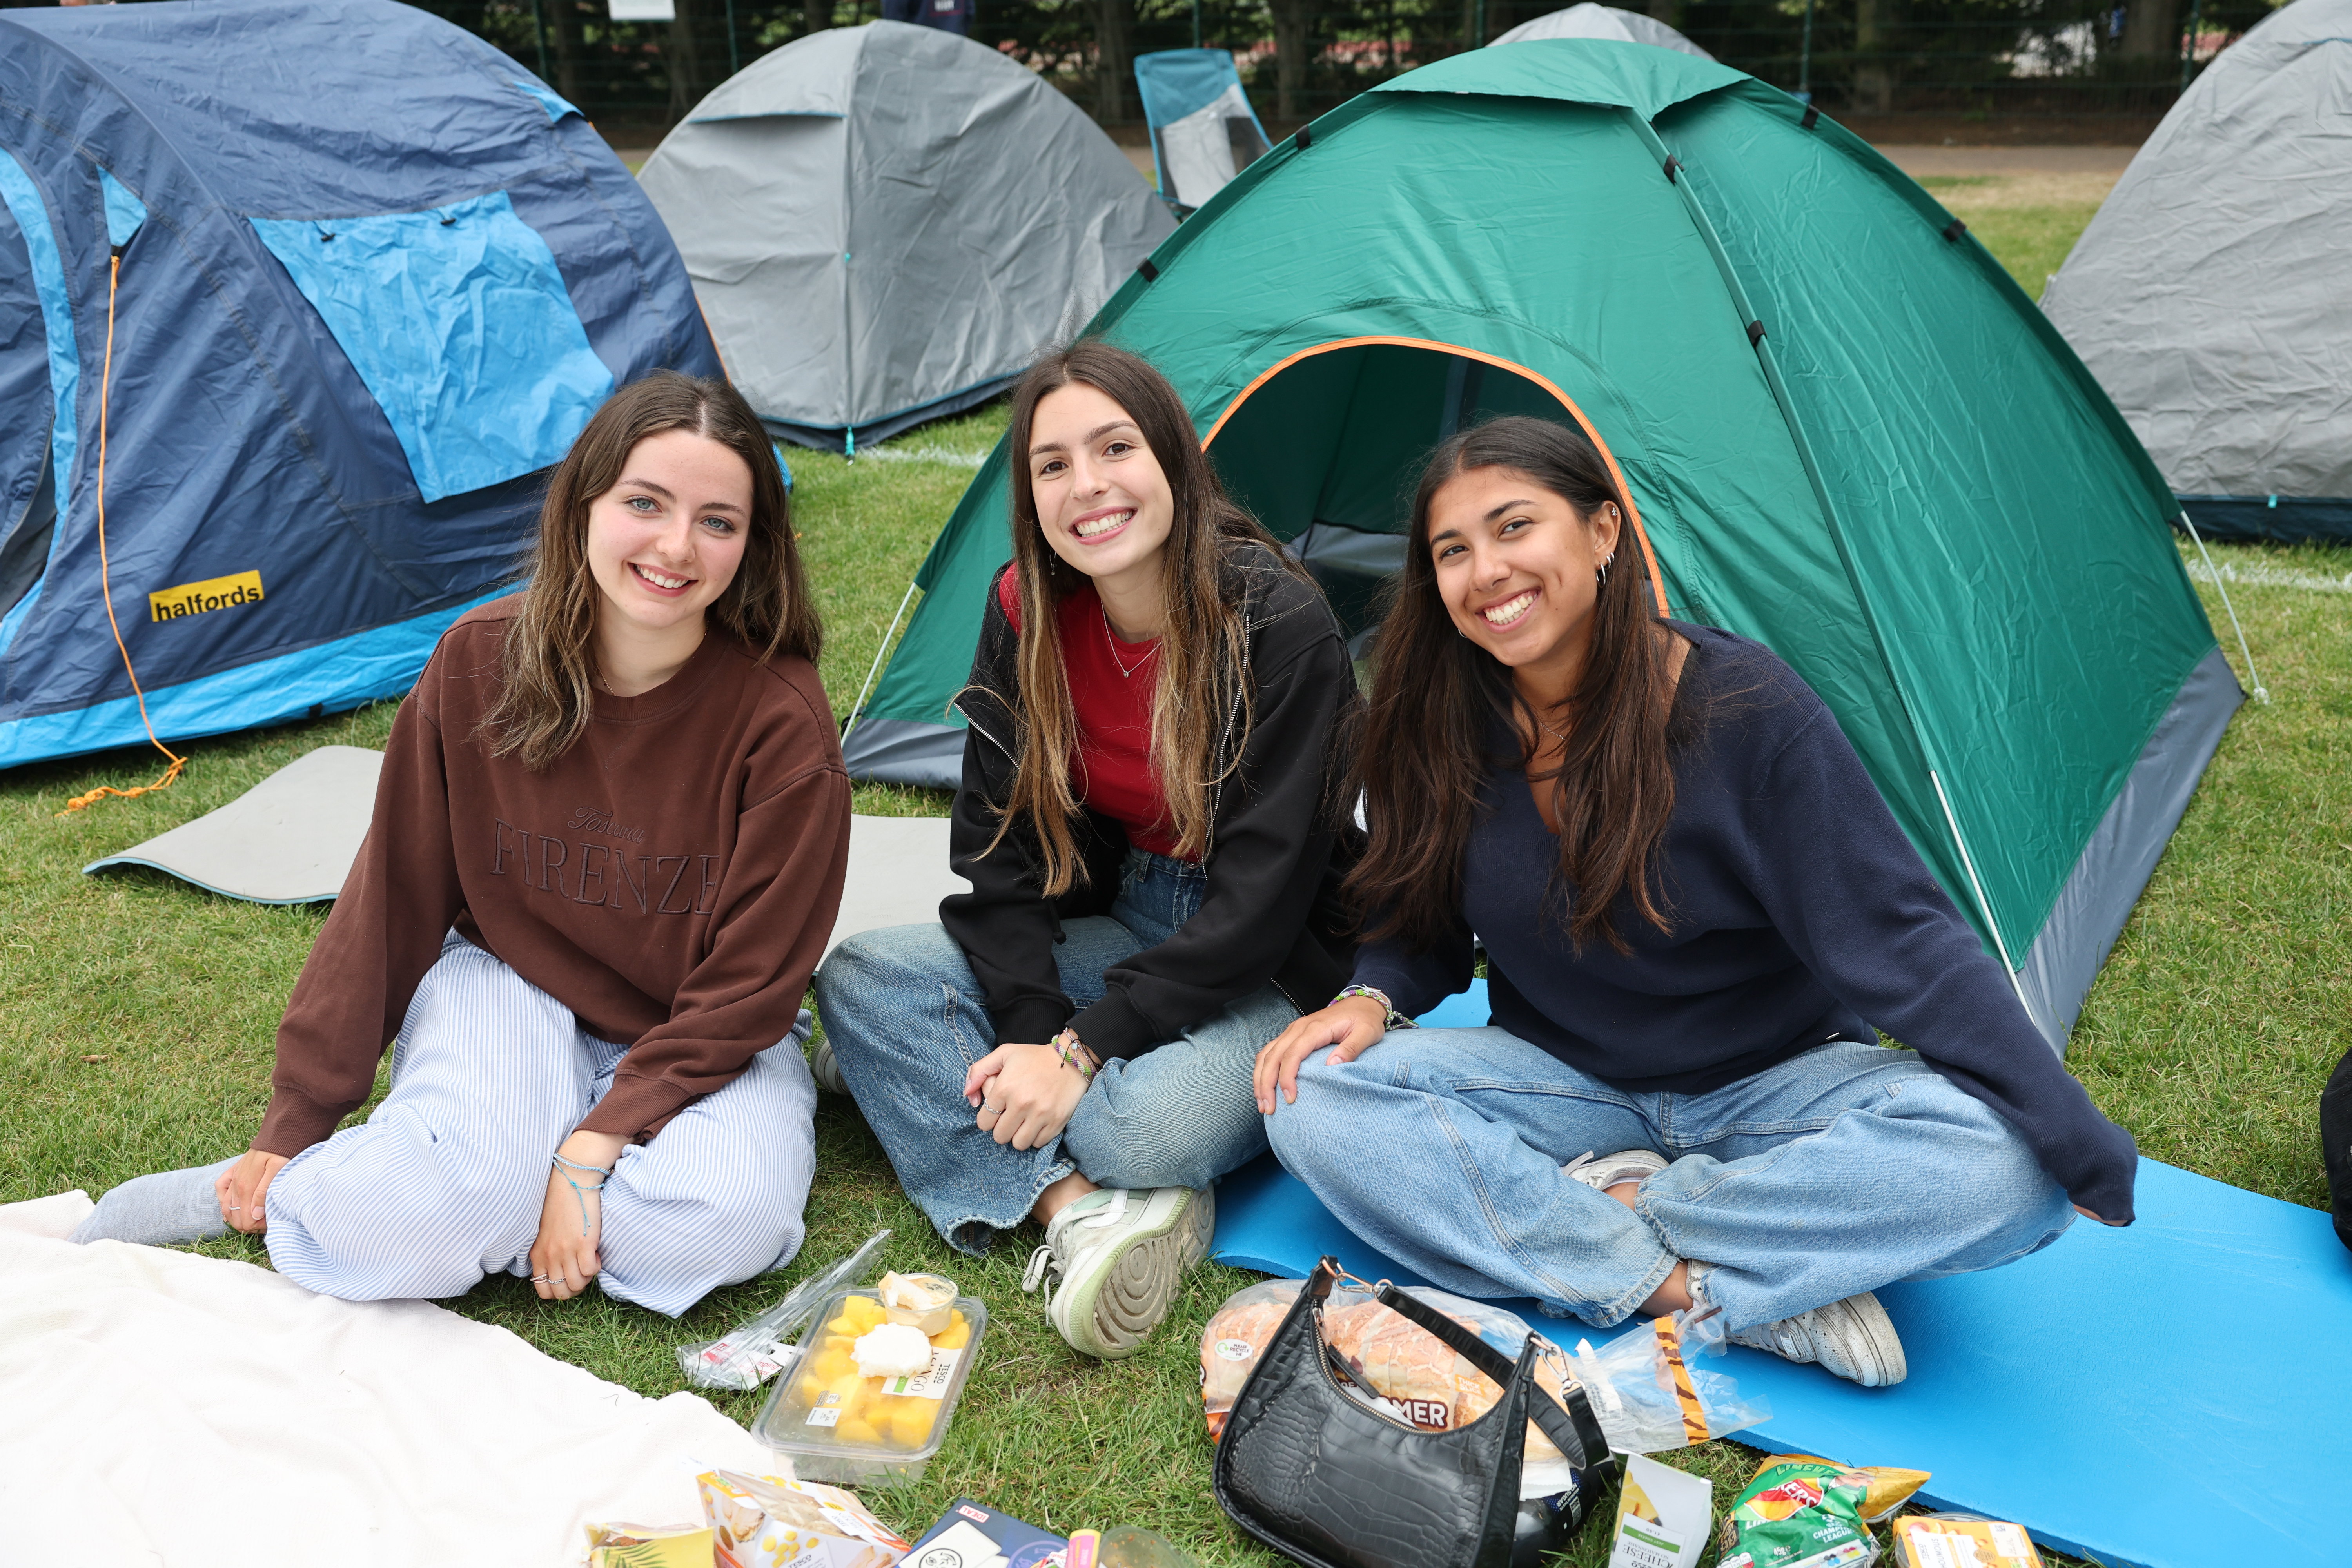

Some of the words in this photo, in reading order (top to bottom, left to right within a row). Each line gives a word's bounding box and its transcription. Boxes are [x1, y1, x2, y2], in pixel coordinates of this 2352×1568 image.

[156, 586, 260, 621] halfords
[568, 806, 645, 844] Toscana
[490, 817, 720, 916] FIRENZE
[937, 1364, 951, 1384] TESCO
[1457, 1377, 1480, 1389] THICK
[1459, 1384, 1482, 1396] SLICE
[963, 1507, 987, 1522] IDEAL
[1638, 1533, 1653, 1543] CHEESE
[1622, 1544, 1670, 1568] CHEESE
[1627, 1541, 1660, 1556] MAYONNAISE
[1918, 1543, 1927, 1560] TESCO
[788, 1554, 812, 1568] TESCO
